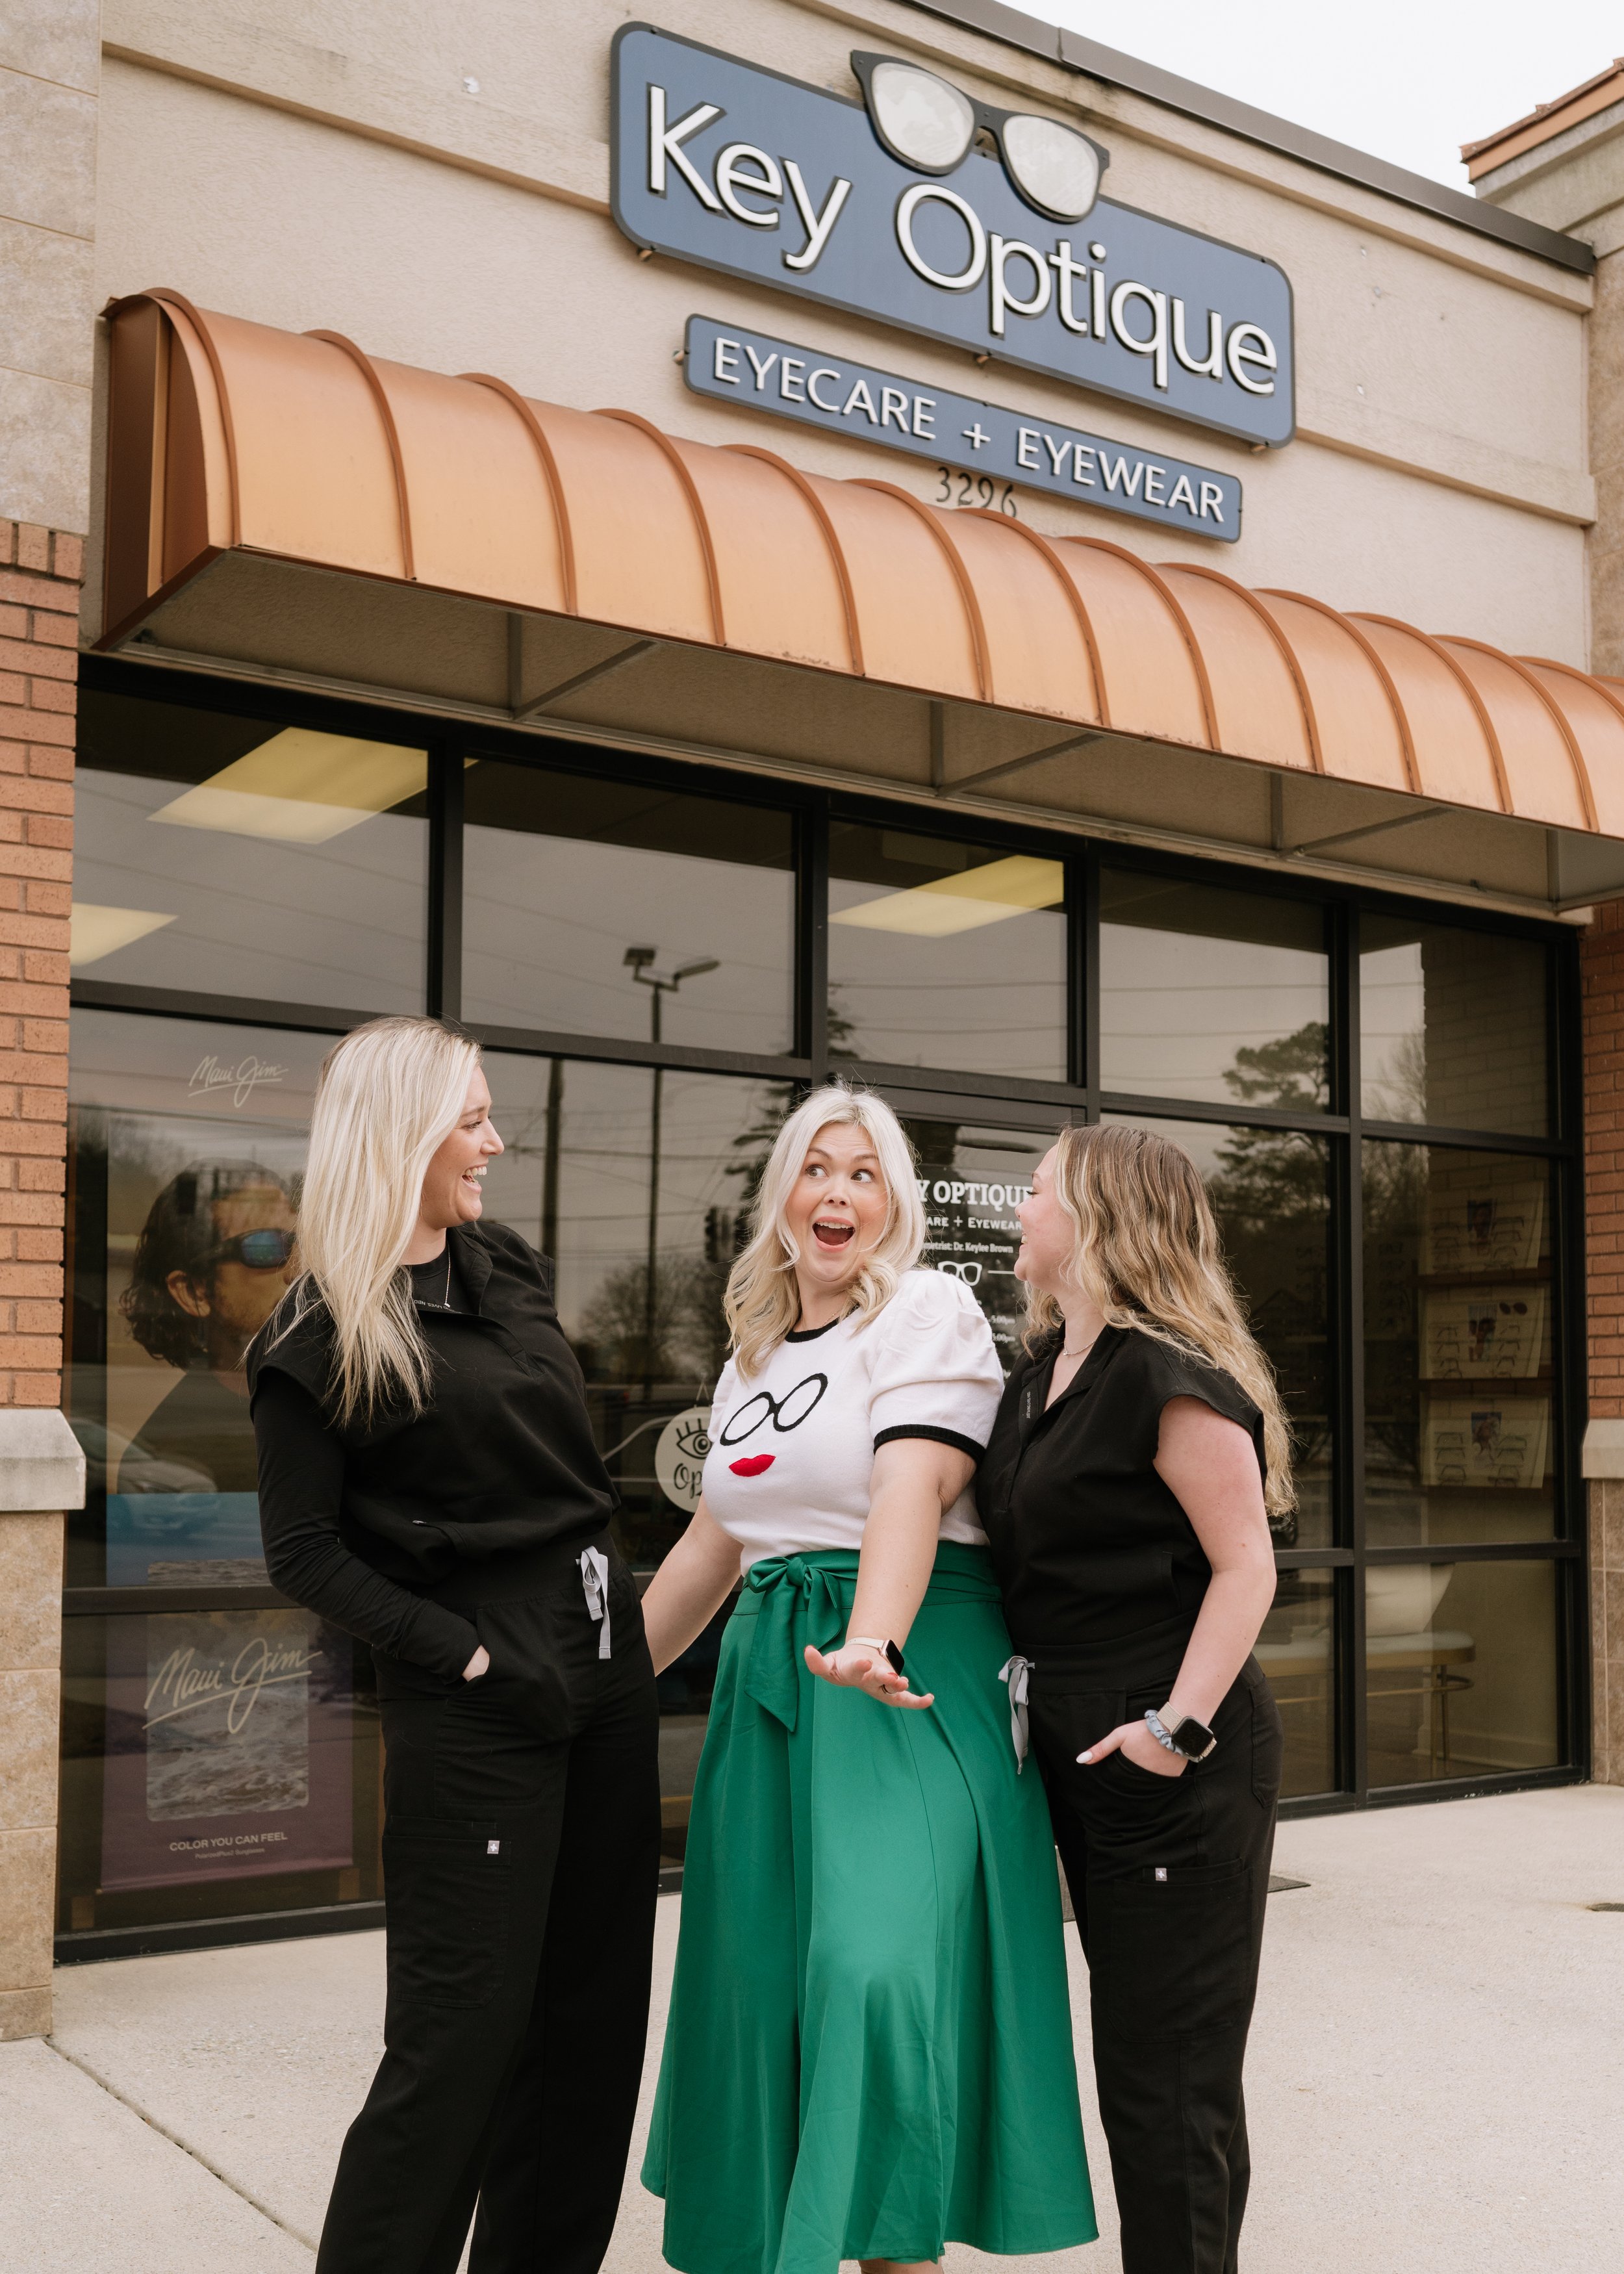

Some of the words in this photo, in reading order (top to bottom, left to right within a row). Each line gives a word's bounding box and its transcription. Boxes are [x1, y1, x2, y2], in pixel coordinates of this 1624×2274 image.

[647, 85, 852, 270] Key
[896, 183, 1278, 395] Optique
[715, 337, 937, 440] EYECARE
[1017, 426, 1224, 522] EYEWEAR
[935, 466, 1017, 518] 3296
[188, 1055, 235, 1088] Maui
[234, 1055, 289, 1108] Jim
[989, 1244, 1014, 1254] Brown
[674, 1463, 702, 1500] Op
[143, 1647, 225, 1710] Maui
[228, 1637, 324, 1734] Jim
[169, 1839, 209, 1852] COLOR
[210, 1837, 234, 1847] YOU
[235, 1834, 259, 1845] CAN
[260, 1831, 288, 1843] FEEL
